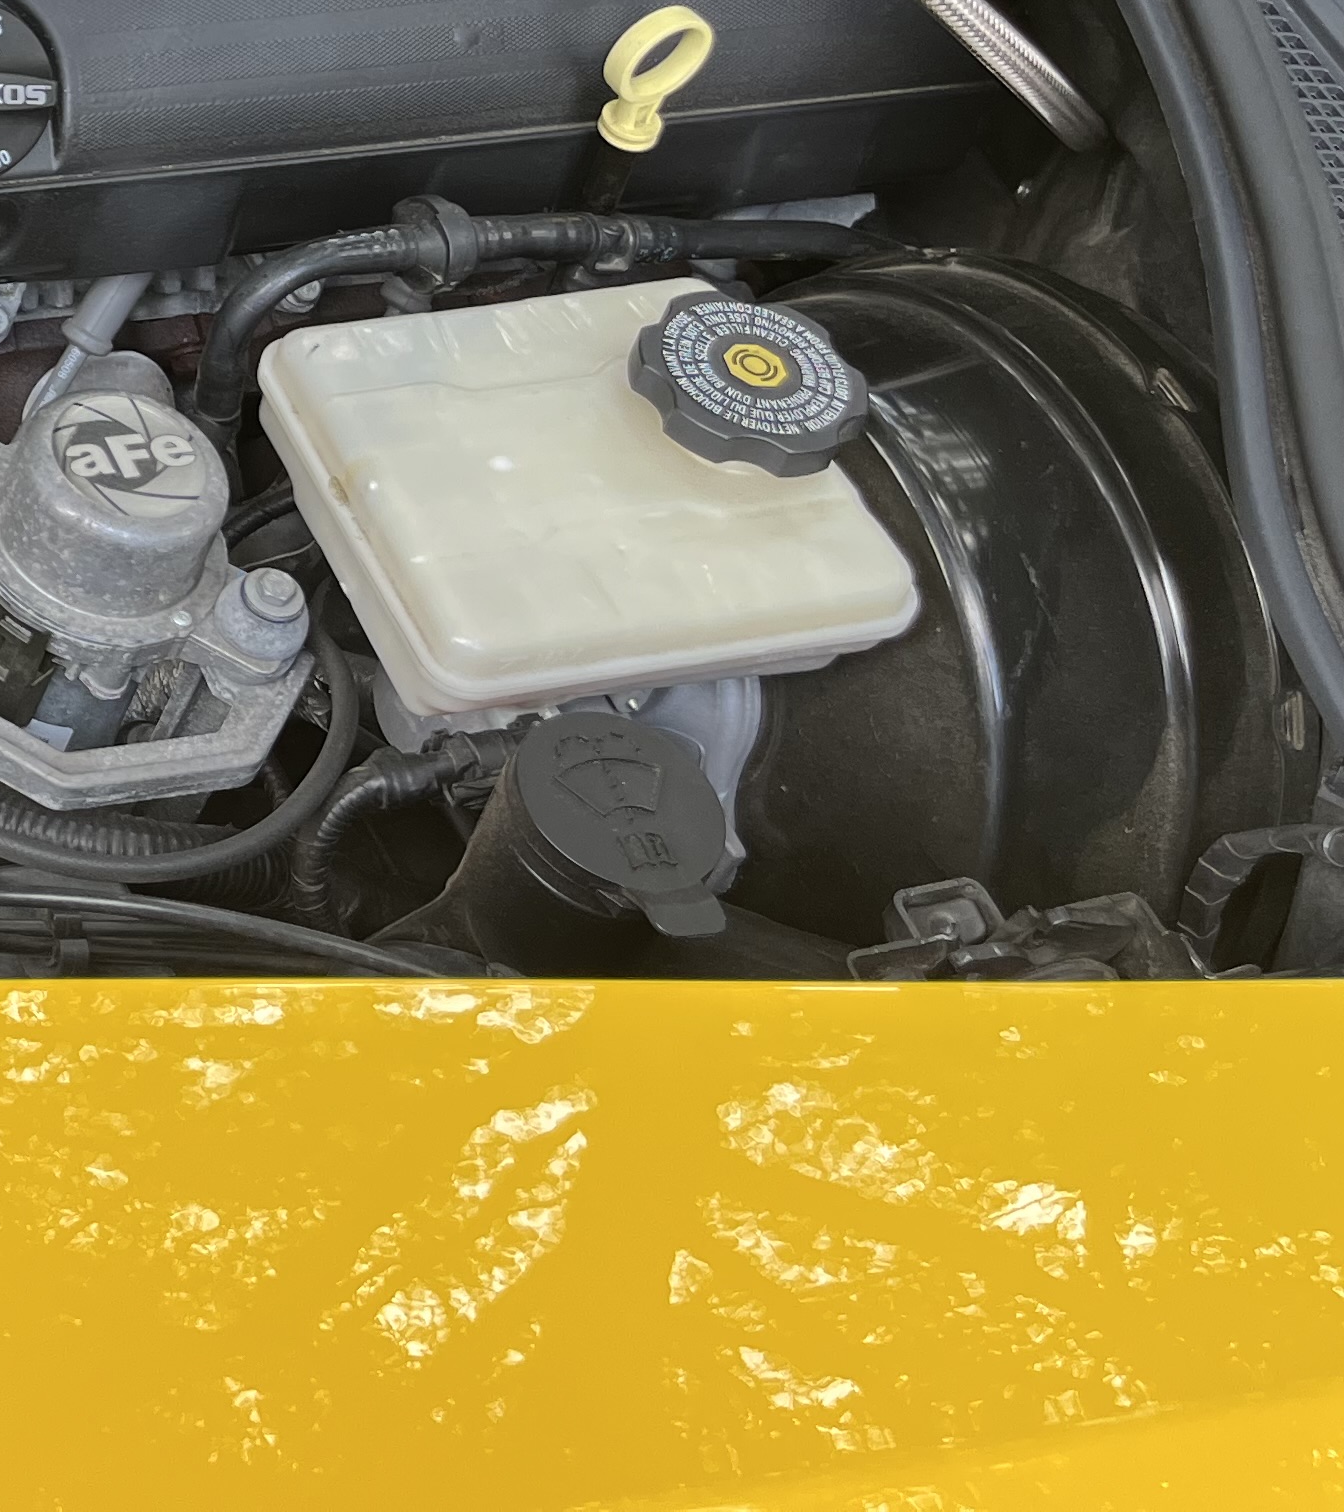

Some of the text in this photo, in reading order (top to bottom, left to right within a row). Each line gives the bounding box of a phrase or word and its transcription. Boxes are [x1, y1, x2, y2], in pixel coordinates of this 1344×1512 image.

[701, 312, 726, 326] ONLY
[727, 312, 748, 323] USE
[754, 307, 794, 327] SEALED
[714, 323, 751, 336] FILLER
[753, 327, 788, 348] CLEAN
[796, 324, 805, 332] A
[662, 338, 676, 348] LA
[802, 331, 830, 352] FROM
[58, 345, 82, 380] 60508
[663, 348, 684, 376] AVANT
[682, 364, 697, 376] DE
[823, 353, 847, 379] FLUID
[698, 362, 726, 389] BIDON
[676, 376, 722, 415] BOUCHON
[690, 374, 728, 405] LIQUIDE
[756, 386, 812, 409] PROVENANT
[724, 410, 738, 423] LE
[730, 402, 746, 415] DU
[750, 408, 774, 420] QUE
[741, 418, 800, 434] NETTOYER
[65, 434, 197, 479] aFe
